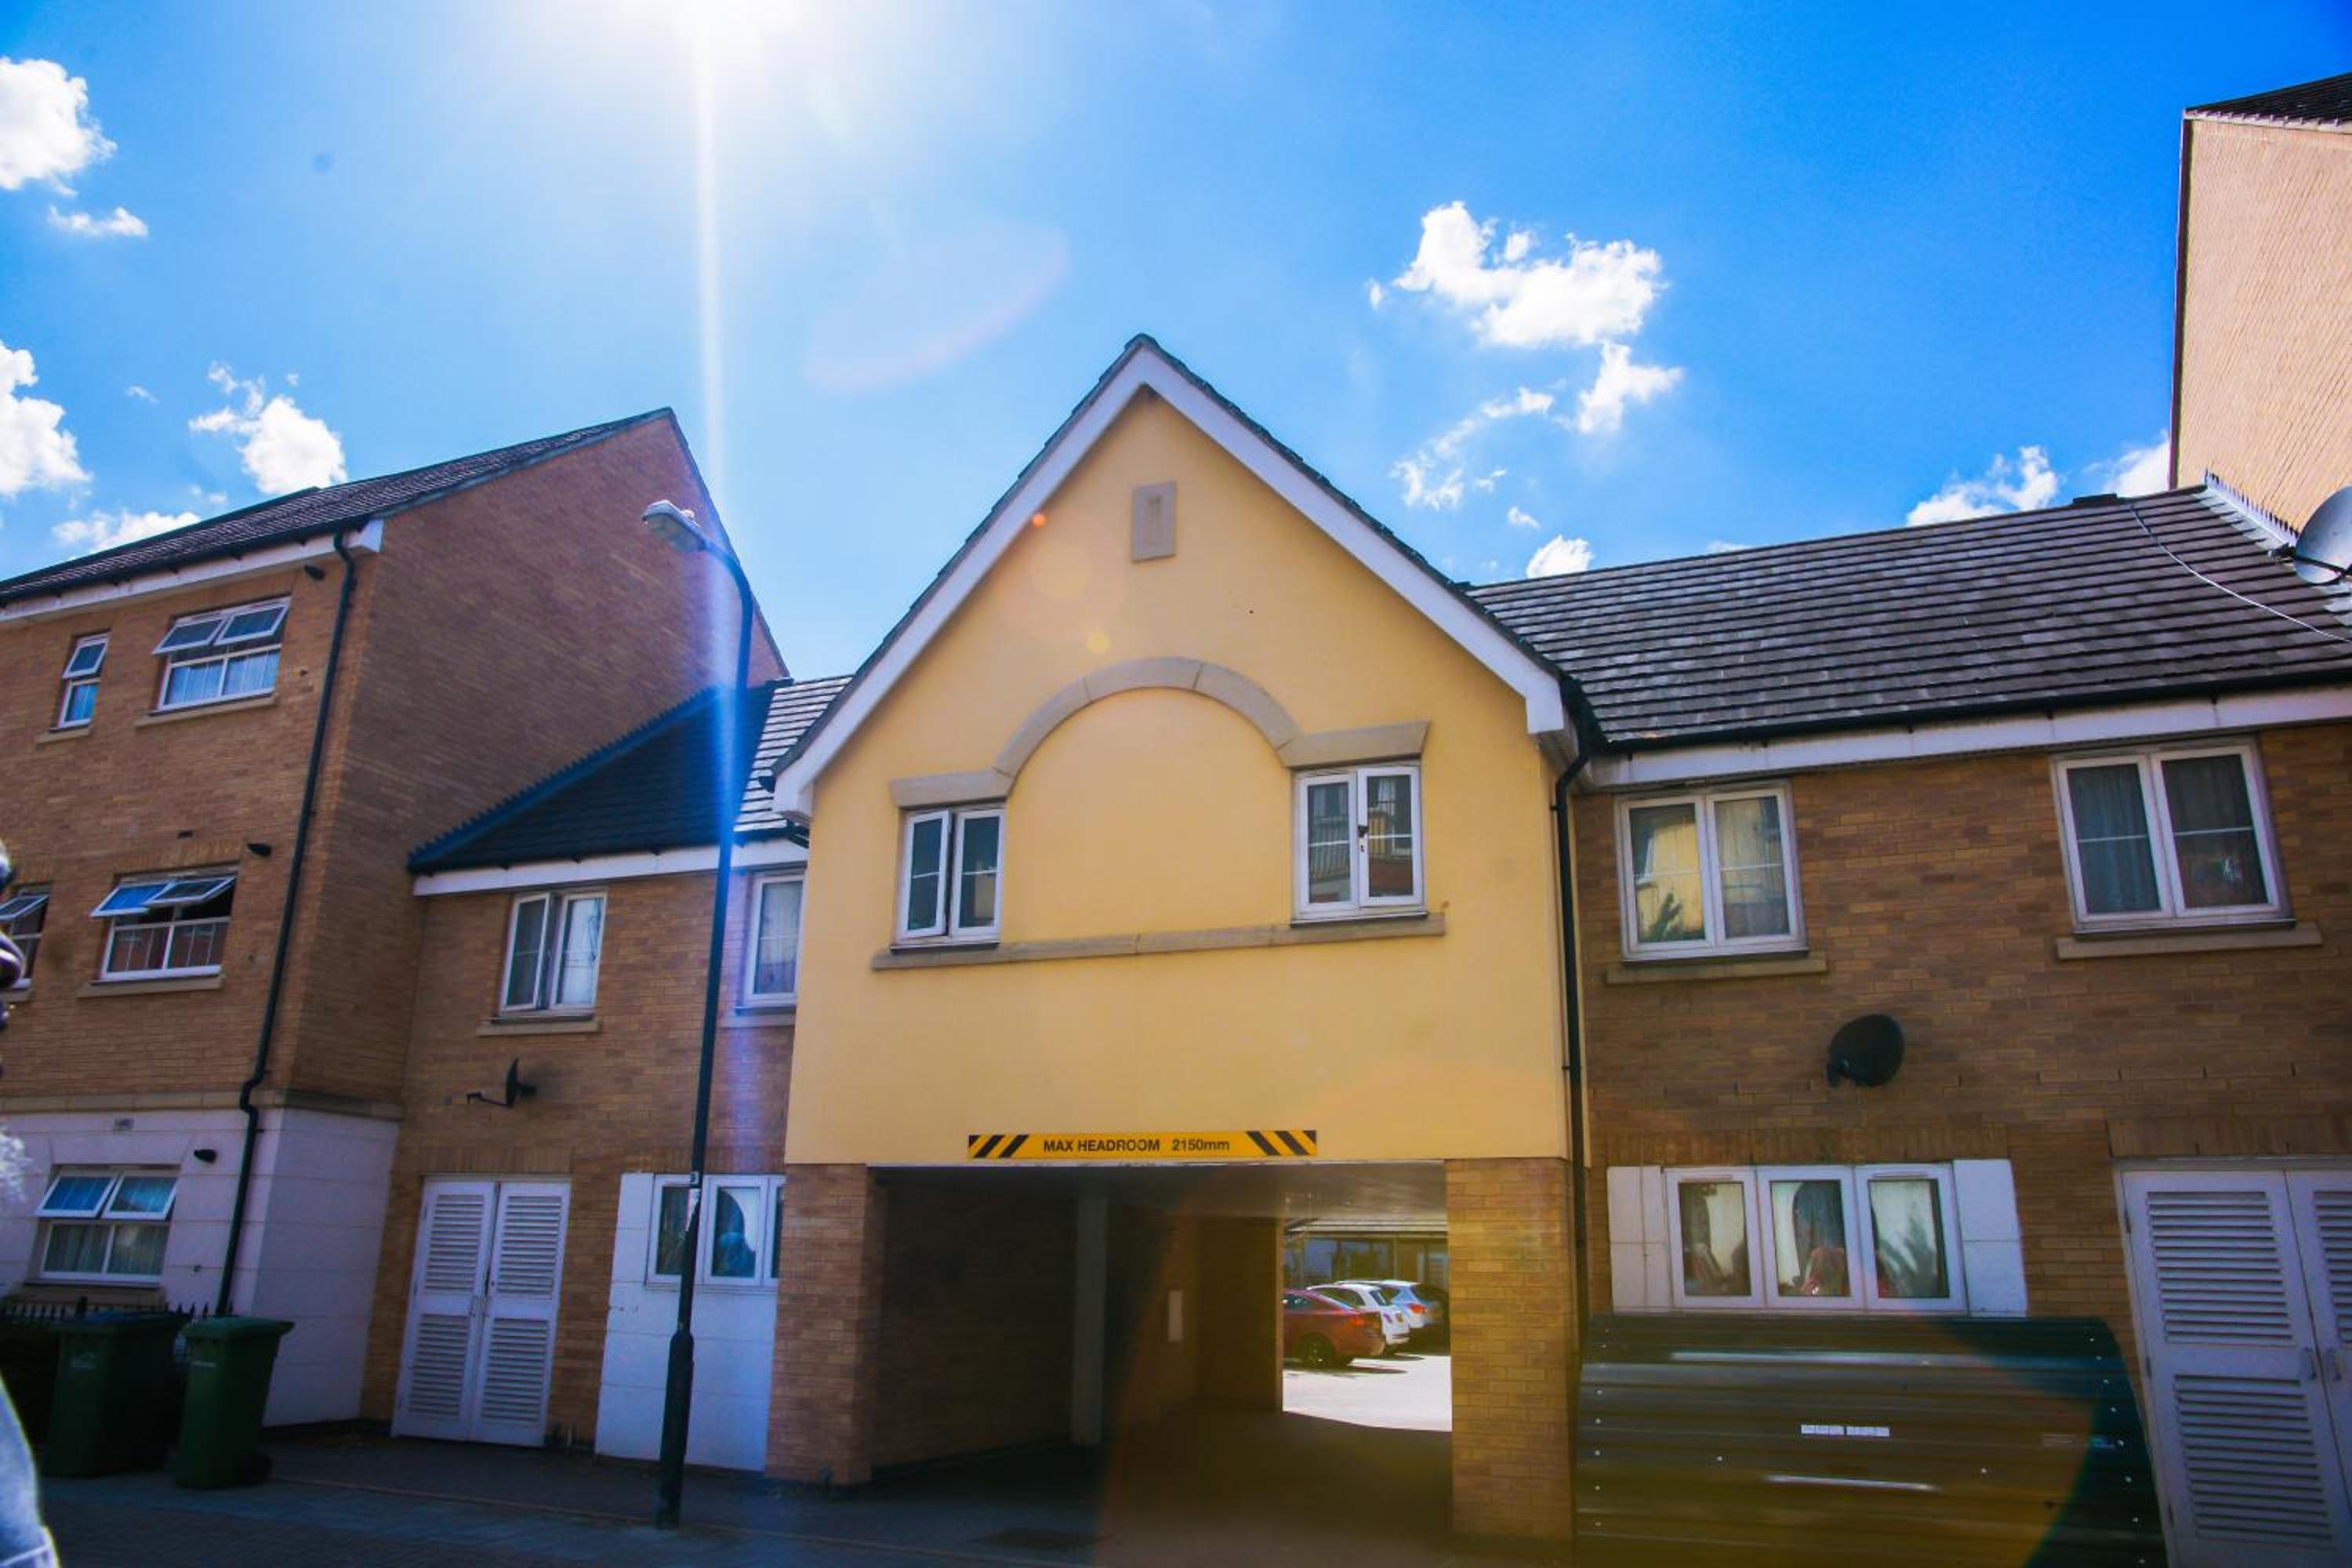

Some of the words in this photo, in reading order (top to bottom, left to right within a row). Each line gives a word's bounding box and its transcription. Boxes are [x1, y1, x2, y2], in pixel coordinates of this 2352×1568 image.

[1044, 1140, 1073, 1152] MAX
[1078, 1139, 1160, 1152] HEADROOM
[1172, 1138, 1230, 1151] 2150mm
